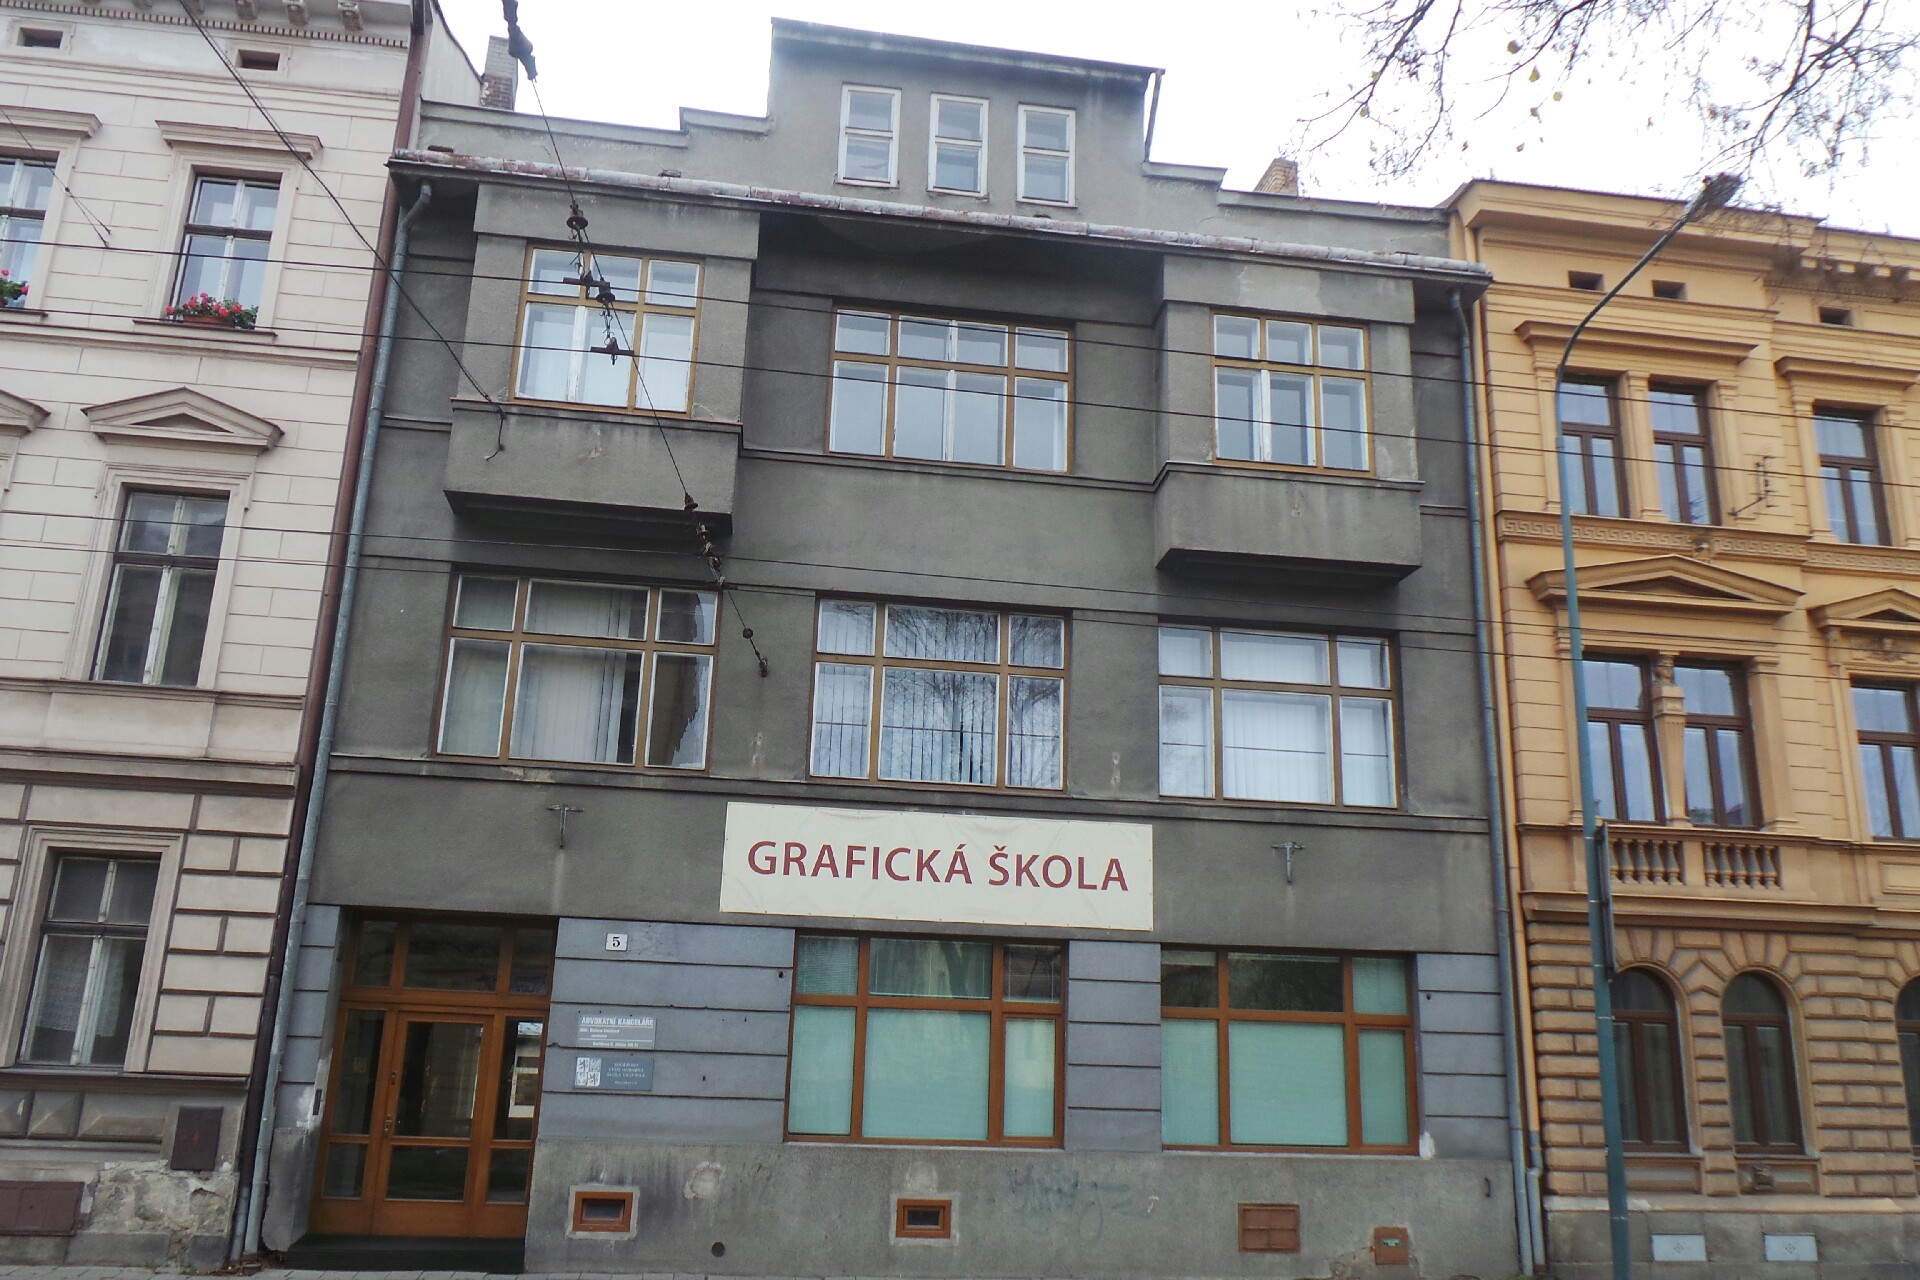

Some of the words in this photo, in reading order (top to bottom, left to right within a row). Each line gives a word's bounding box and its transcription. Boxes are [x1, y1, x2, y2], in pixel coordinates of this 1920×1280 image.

[747, 840, 973, 885] GRAFICKÁ
[987, 844, 1129, 892] ŠKOLA
[612, 936, 621, 948] 5
[582, 1016, 616, 1025] ADVOKÁTNÍ
